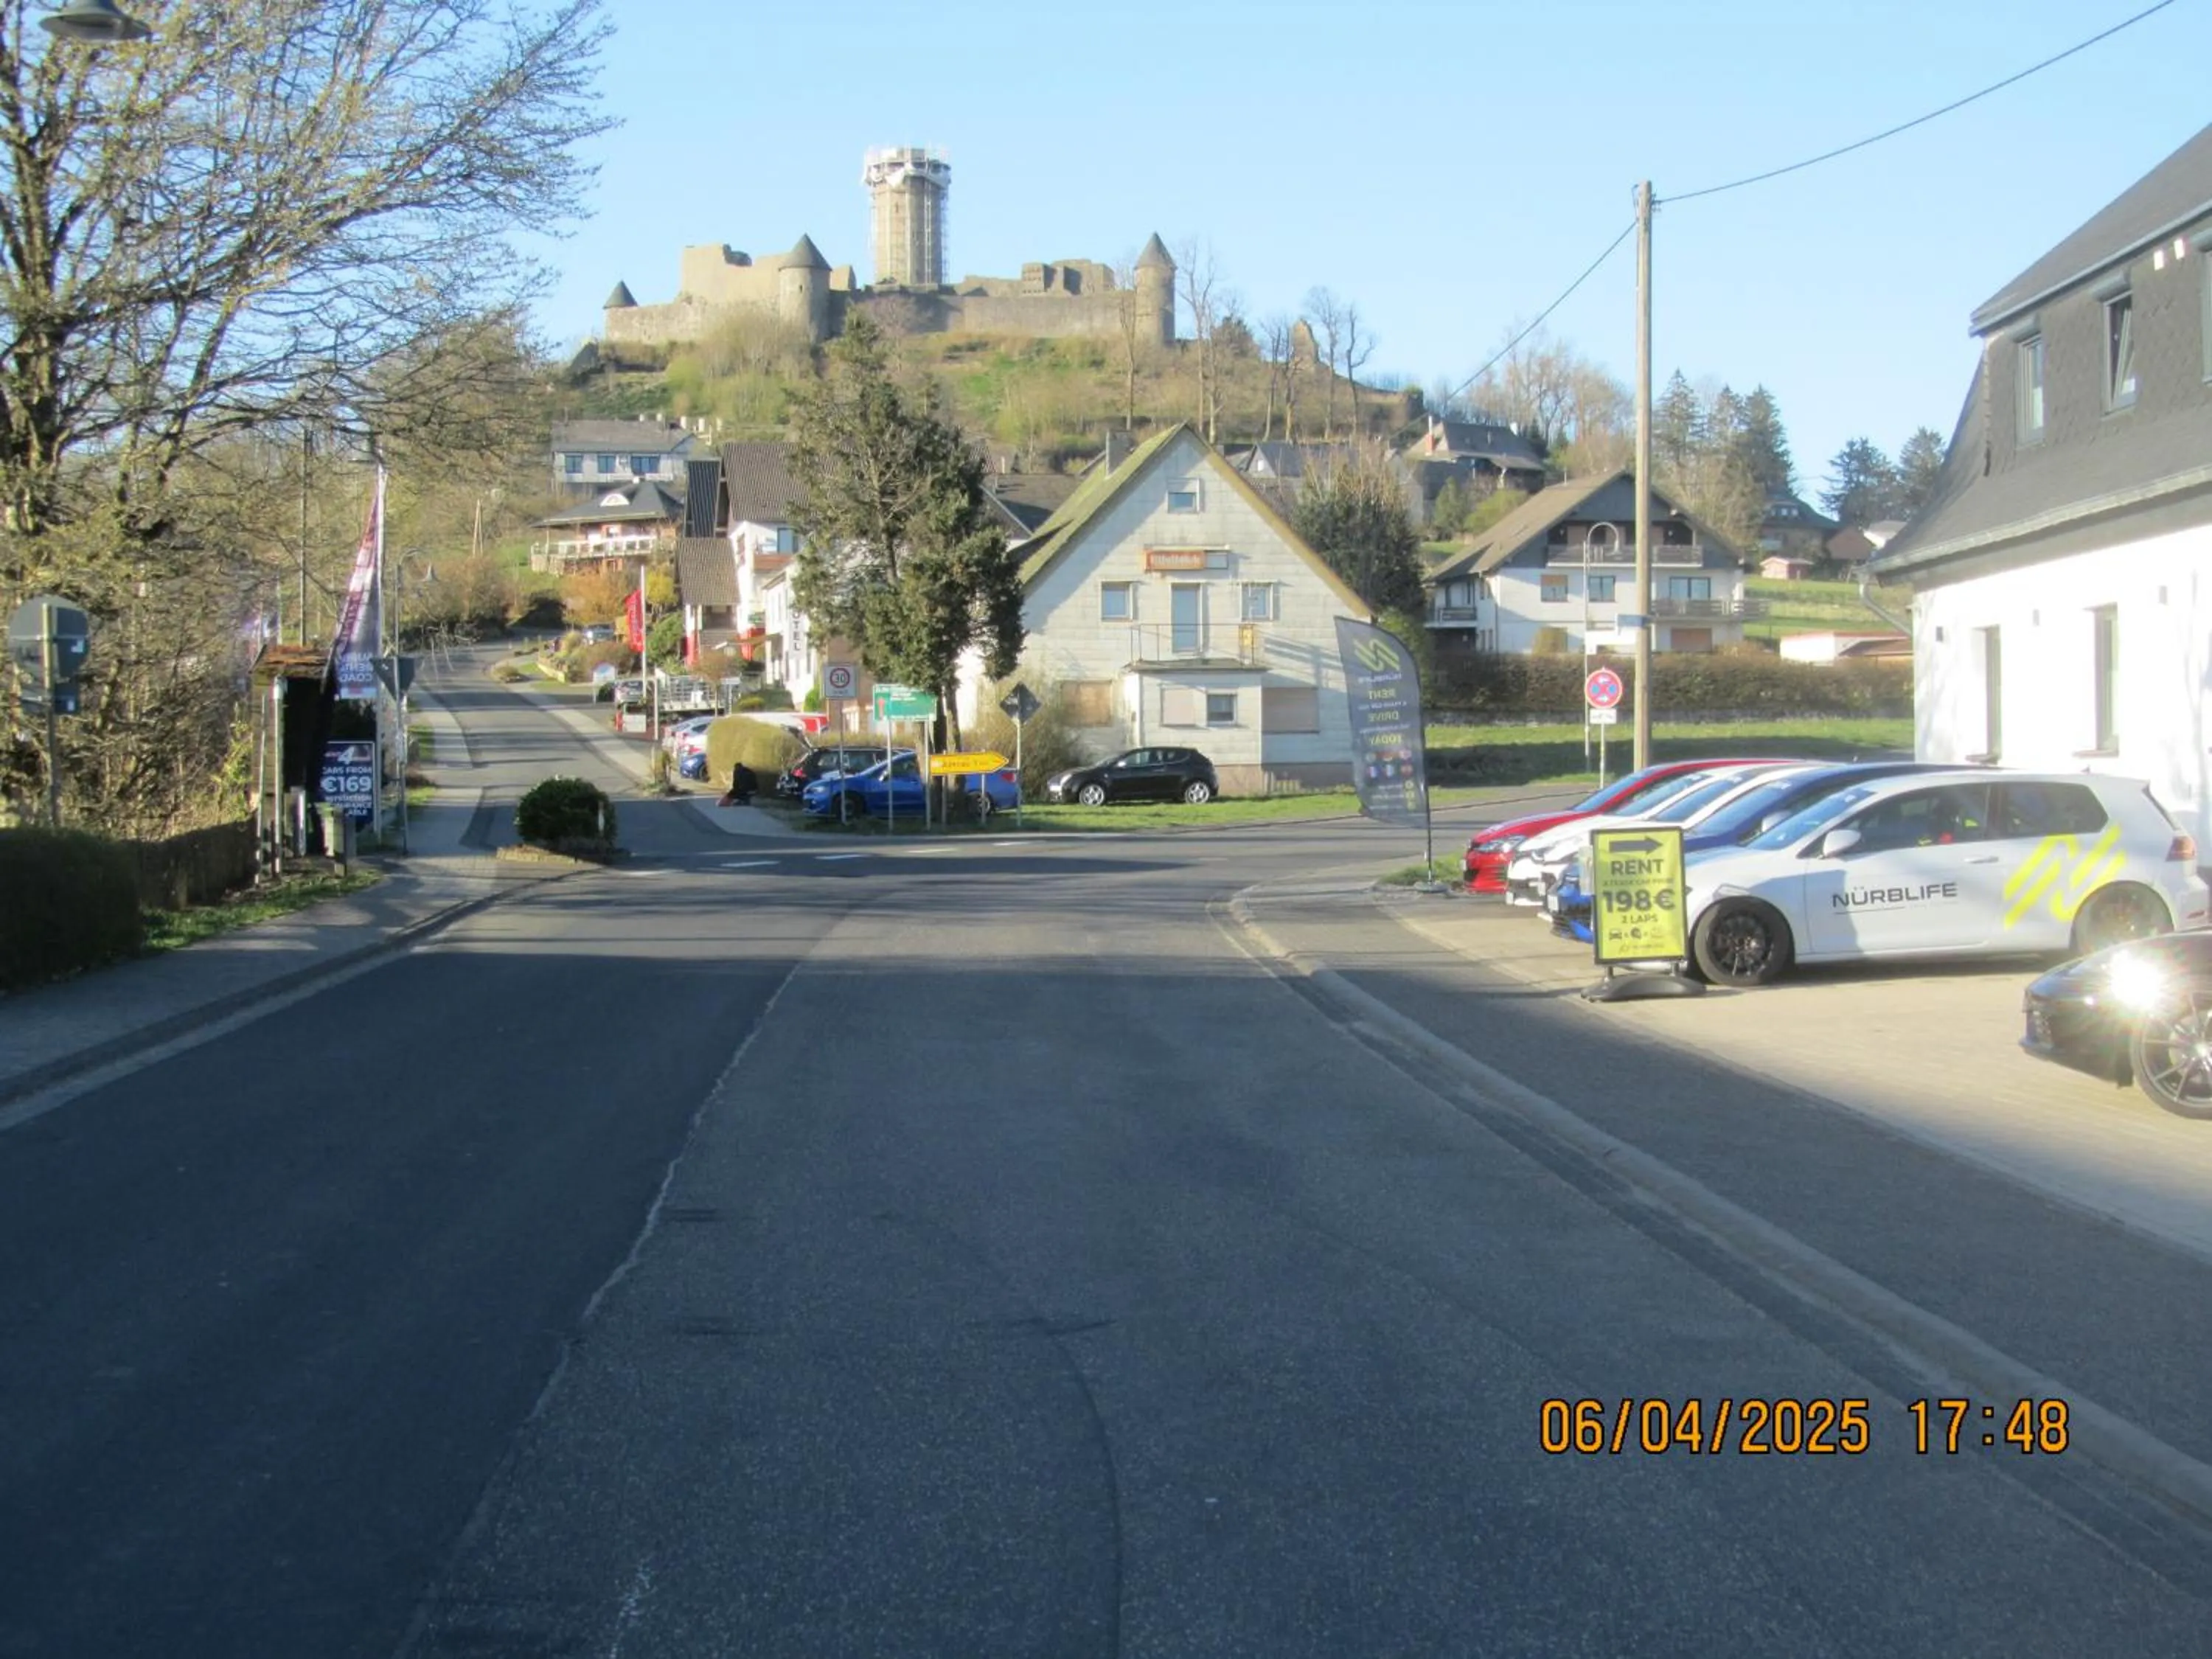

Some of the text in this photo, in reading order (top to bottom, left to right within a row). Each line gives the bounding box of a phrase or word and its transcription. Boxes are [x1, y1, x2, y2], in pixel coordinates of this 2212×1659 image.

[793, 611, 801, 650] OTEL
[321, 776, 372, 793] €169
[1610, 858, 1664, 876] RENT
[1602, 888, 1676, 914] 198€
[1832, 882, 1958, 908] NÜRBLIFE
[1630, 914, 1658, 924] LAPS
